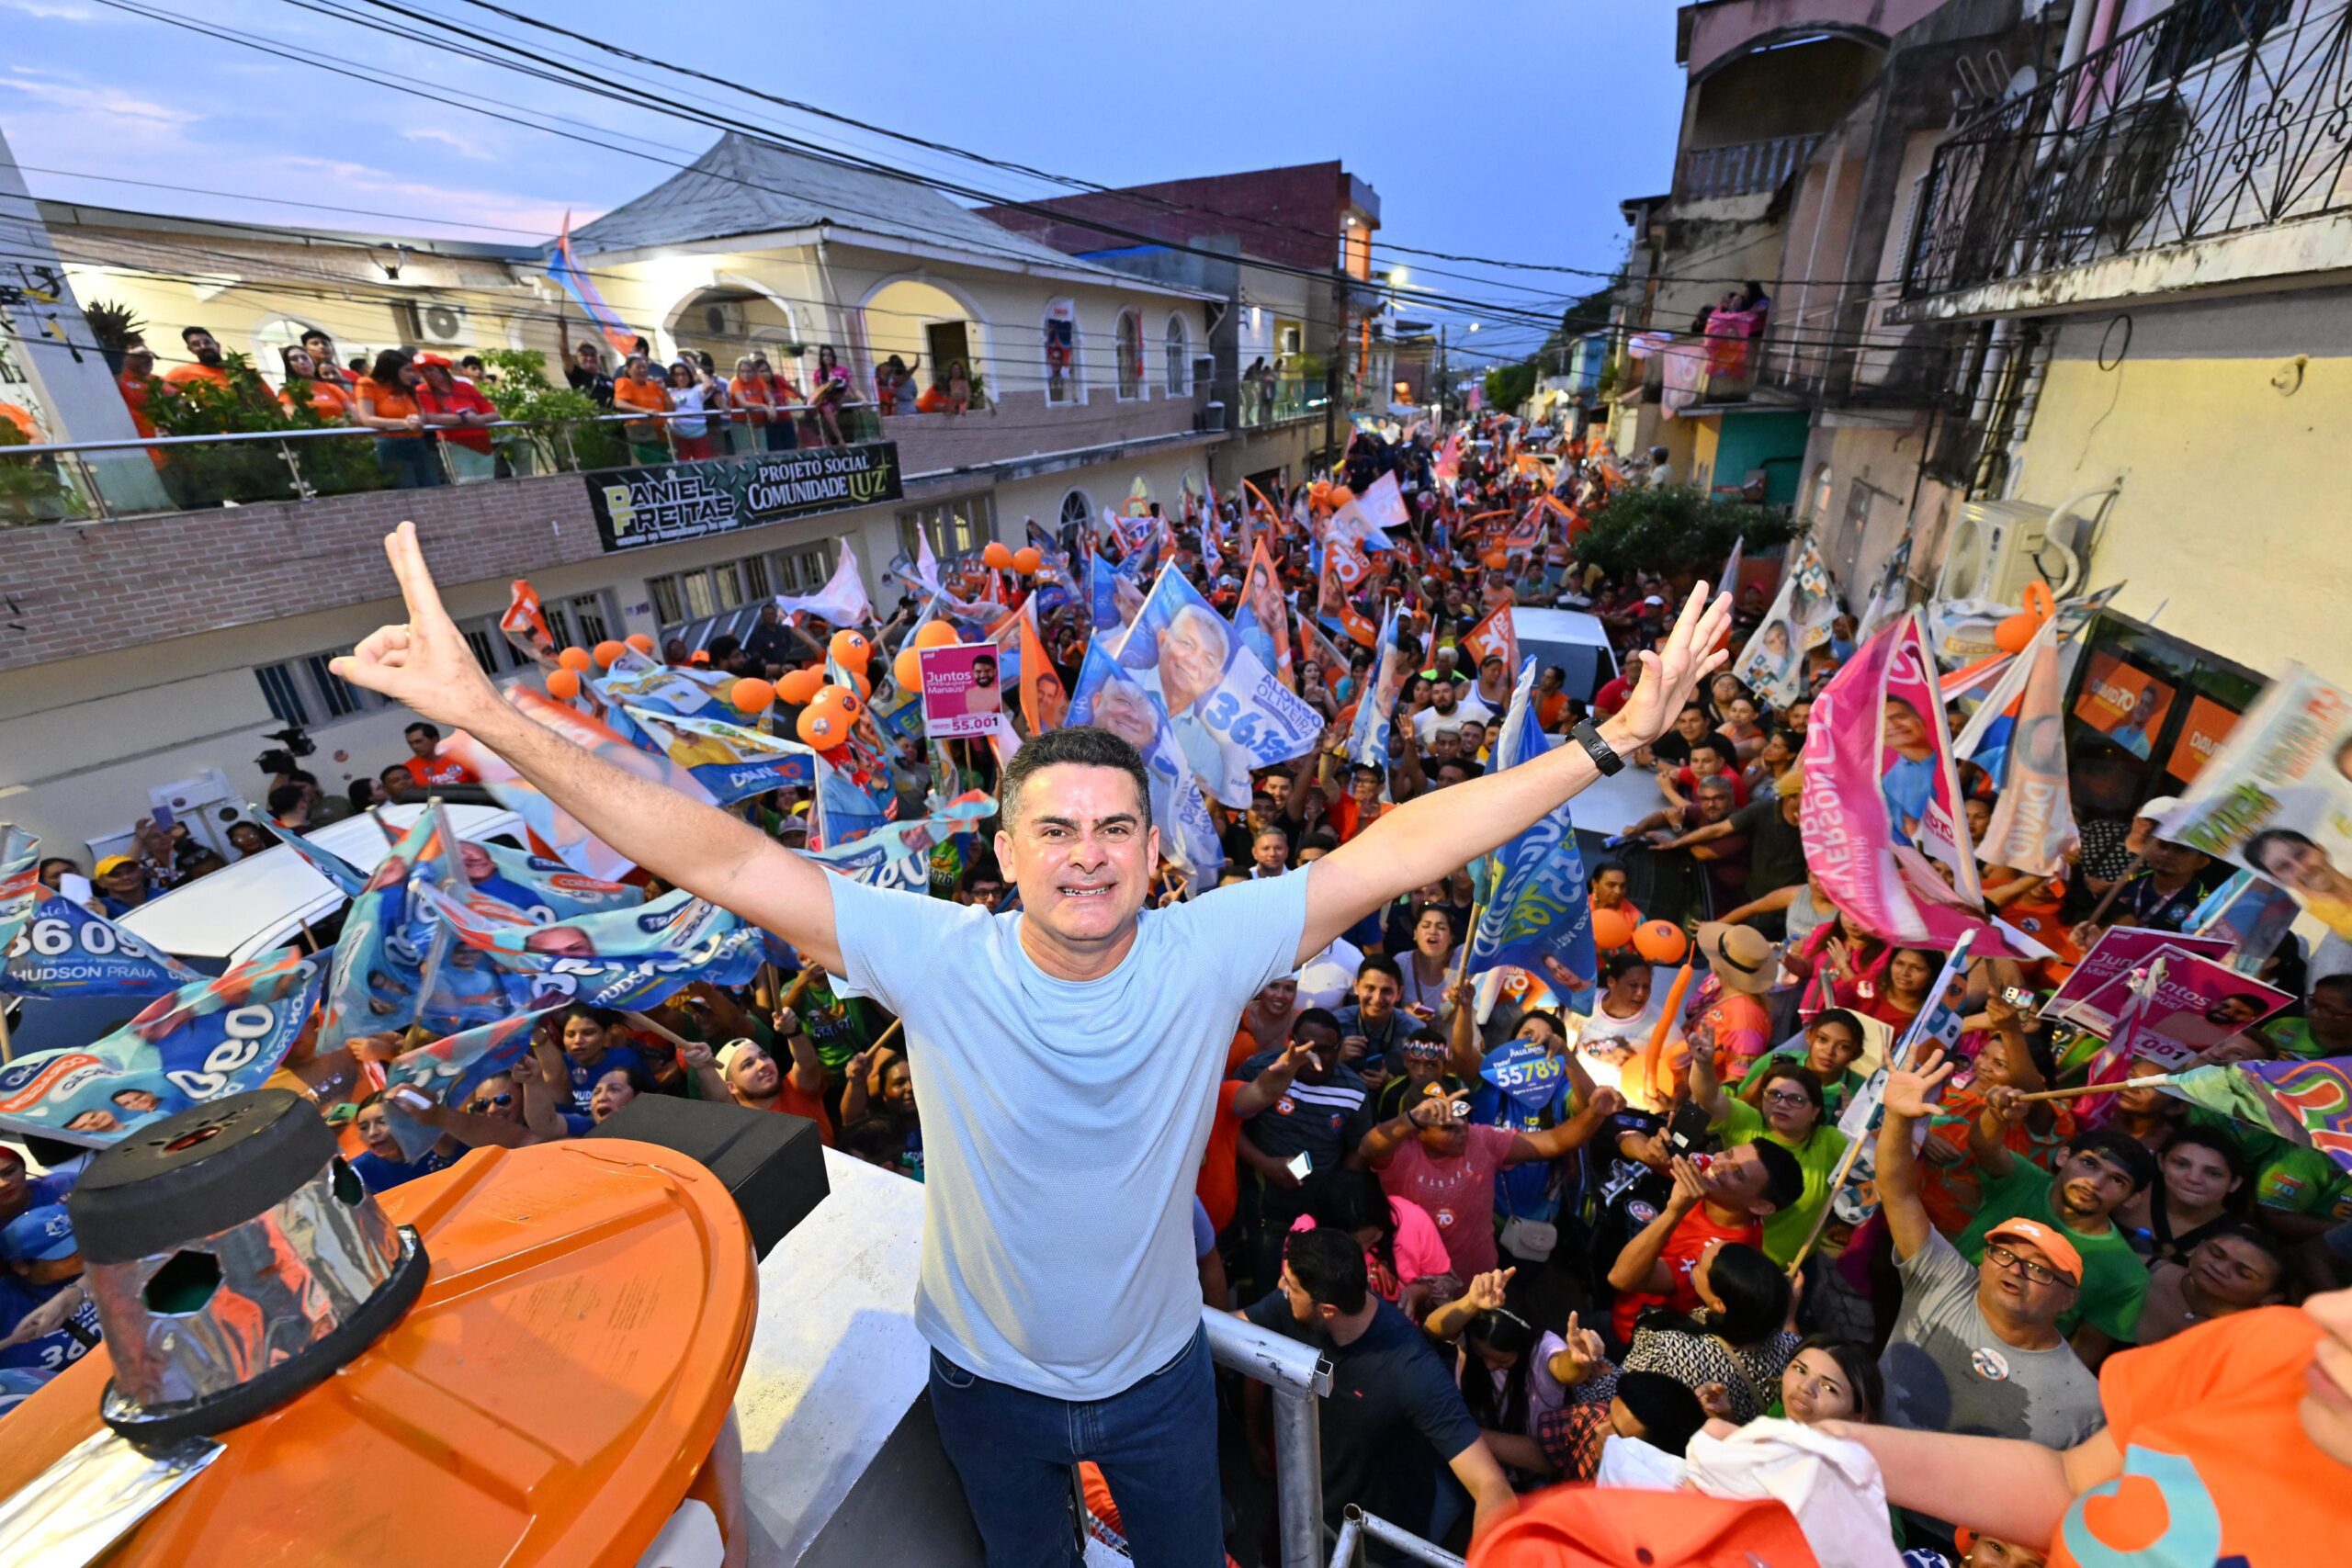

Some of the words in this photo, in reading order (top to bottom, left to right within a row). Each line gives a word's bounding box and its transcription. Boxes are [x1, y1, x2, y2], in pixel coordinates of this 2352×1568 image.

[759, 460, 821, 483] PROJETO
[825, 456, 870, 474] SOCIAL
[848, 469, 887, 502] LUZ
[603, 476, 716, 509] DANIEL
[611, 494, 735, 536] FREITAS
[926, 671, 971, 683] Juntos
[1256, 682, 1315, 737] OLIVEIRA
[1261, 673, 1323, 728] ALONSO
[952, 716, 999, 731] 55.001
[107, 966, 158, 979] PRAIA
[1497, 1057, 1560, 1088] 55789
